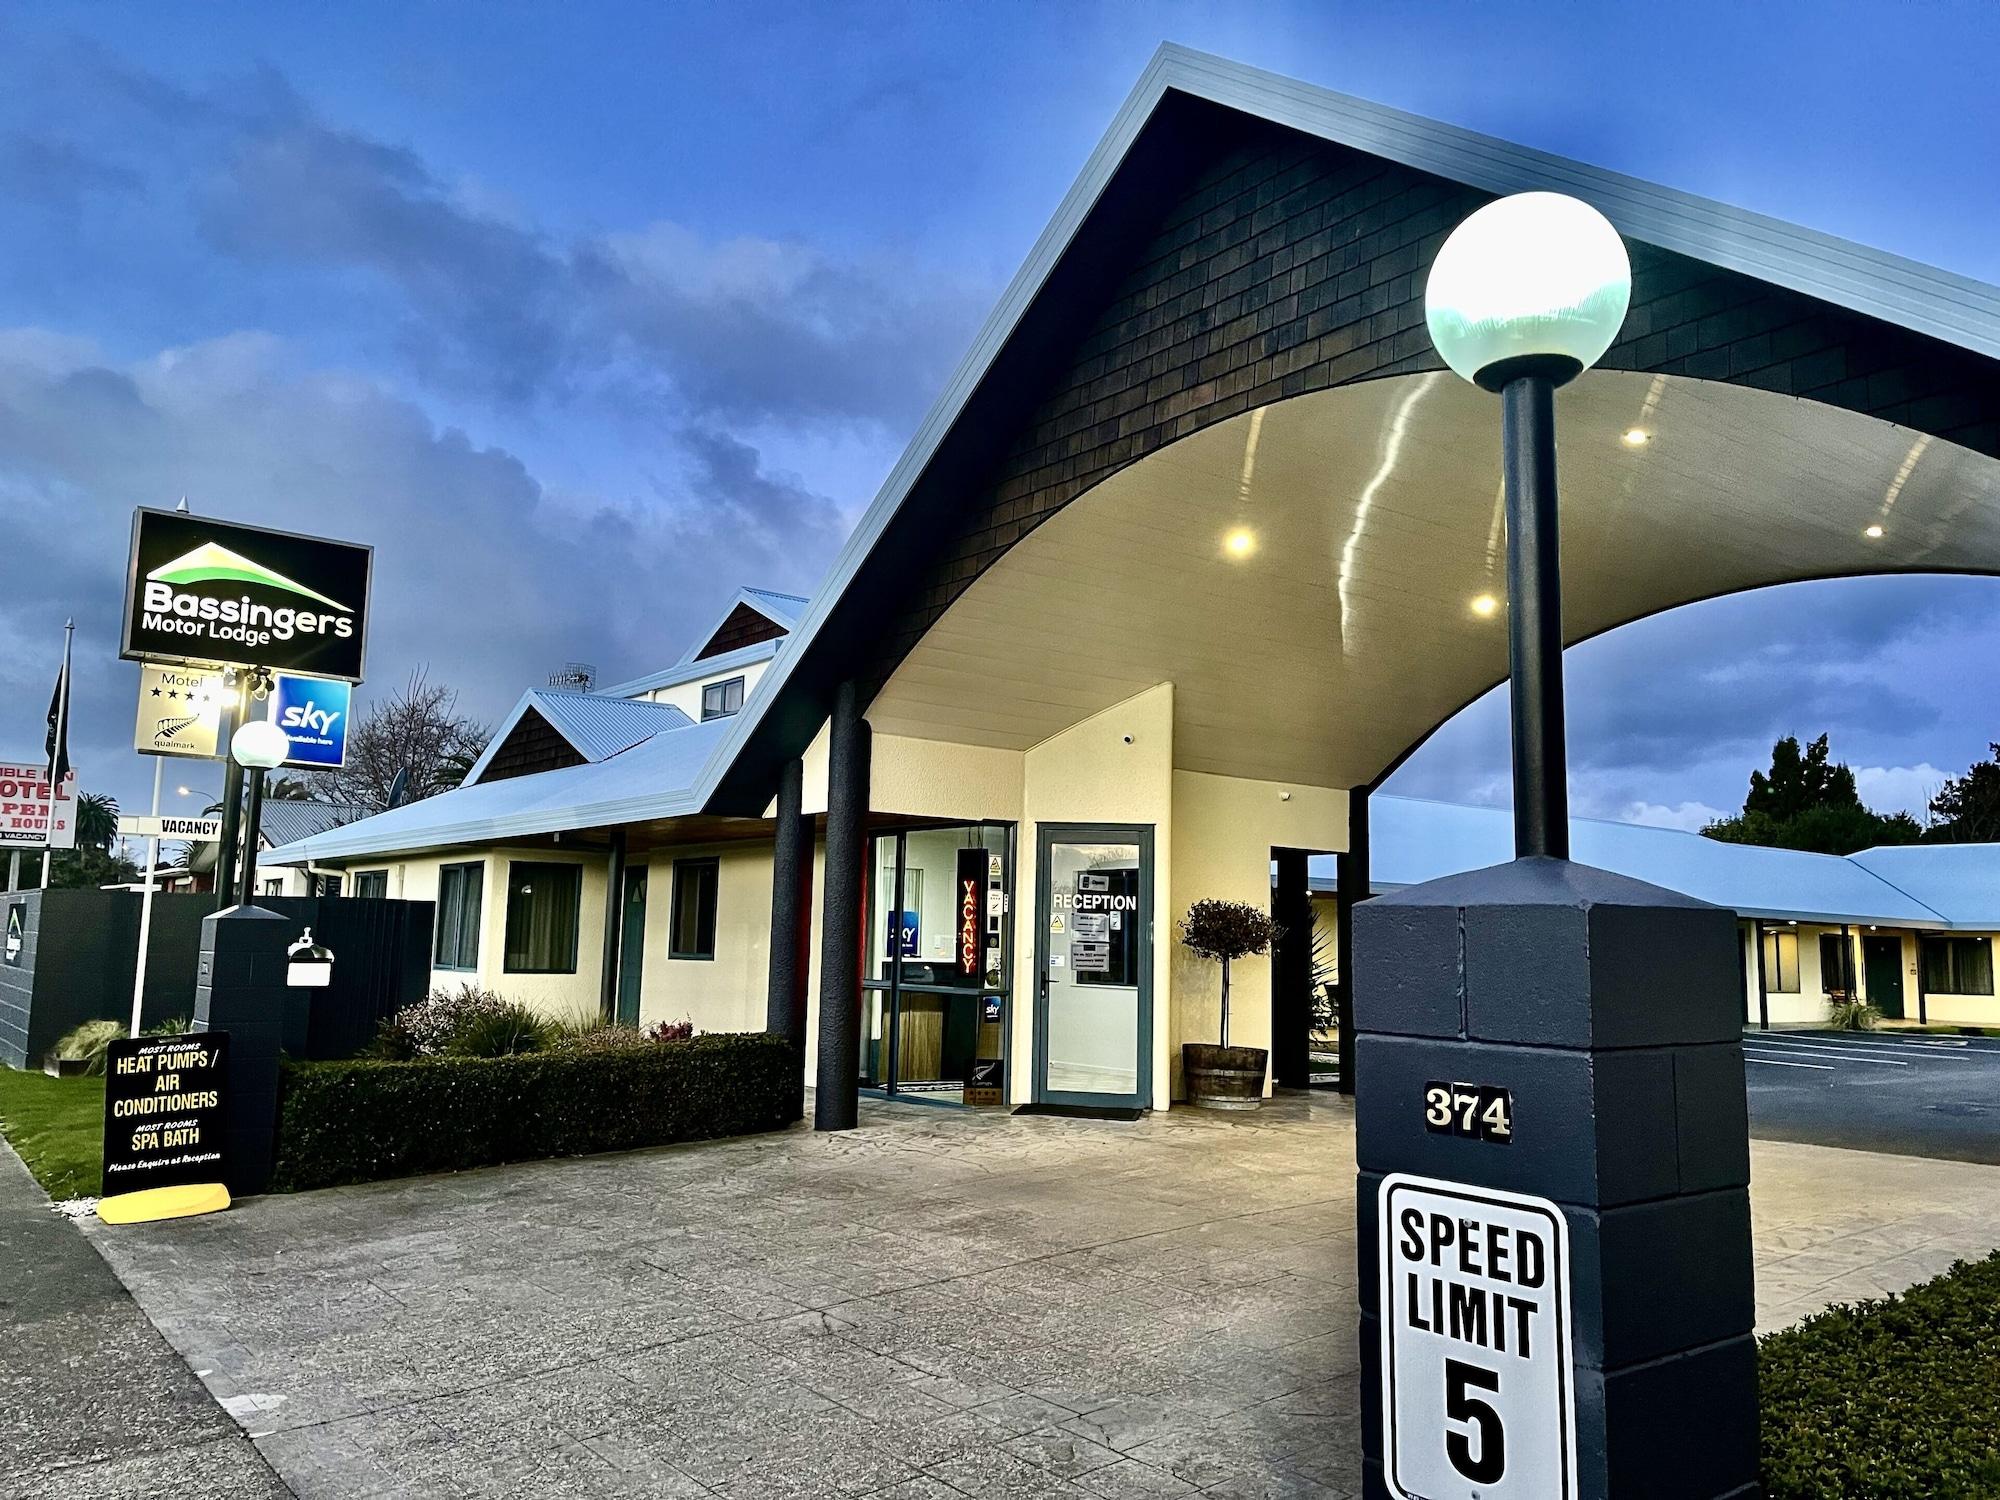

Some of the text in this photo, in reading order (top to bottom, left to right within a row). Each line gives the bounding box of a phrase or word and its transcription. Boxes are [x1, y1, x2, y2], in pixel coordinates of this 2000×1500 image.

[143, 582, 353, 640] Bassingers
[142, 612, 270, 647] Motor Lodge
[281, 700, 341, 735] sky
[154, 740, 195, 750] qualmark
[5, 832, 46, 840] VACANCY
[161, 819, 218, 836] VACANCY
[1053, 893, 1137, 911] RECEPTION
[962, 880, 975, 974] VACANCY
[985, 1004, 999, 1015] sky
[138, 1043, 201, 1055] MOST ROOMS
[117, 1055, 153, 1074] HEAT
[157, 1050, 208, 1071] PUMPS
[155, 1074, 180, 1092] AIR
[114, 1091, 218, 1117] CONDITIONERS
[1426, 1087, 1511, 1136] 374
[135, 1119, 198, 1132] MOST ROOMS
[131, 1127, 200, 1151] SPA BATH
[108, 1153, 221, 1172] Please Enquire at Reception
[1400, 1208, 1545, 1289] SPEED
[1407, 1272, 1538, 1360] LIMIT
[1445, 1357, 1506, 1486] 5
